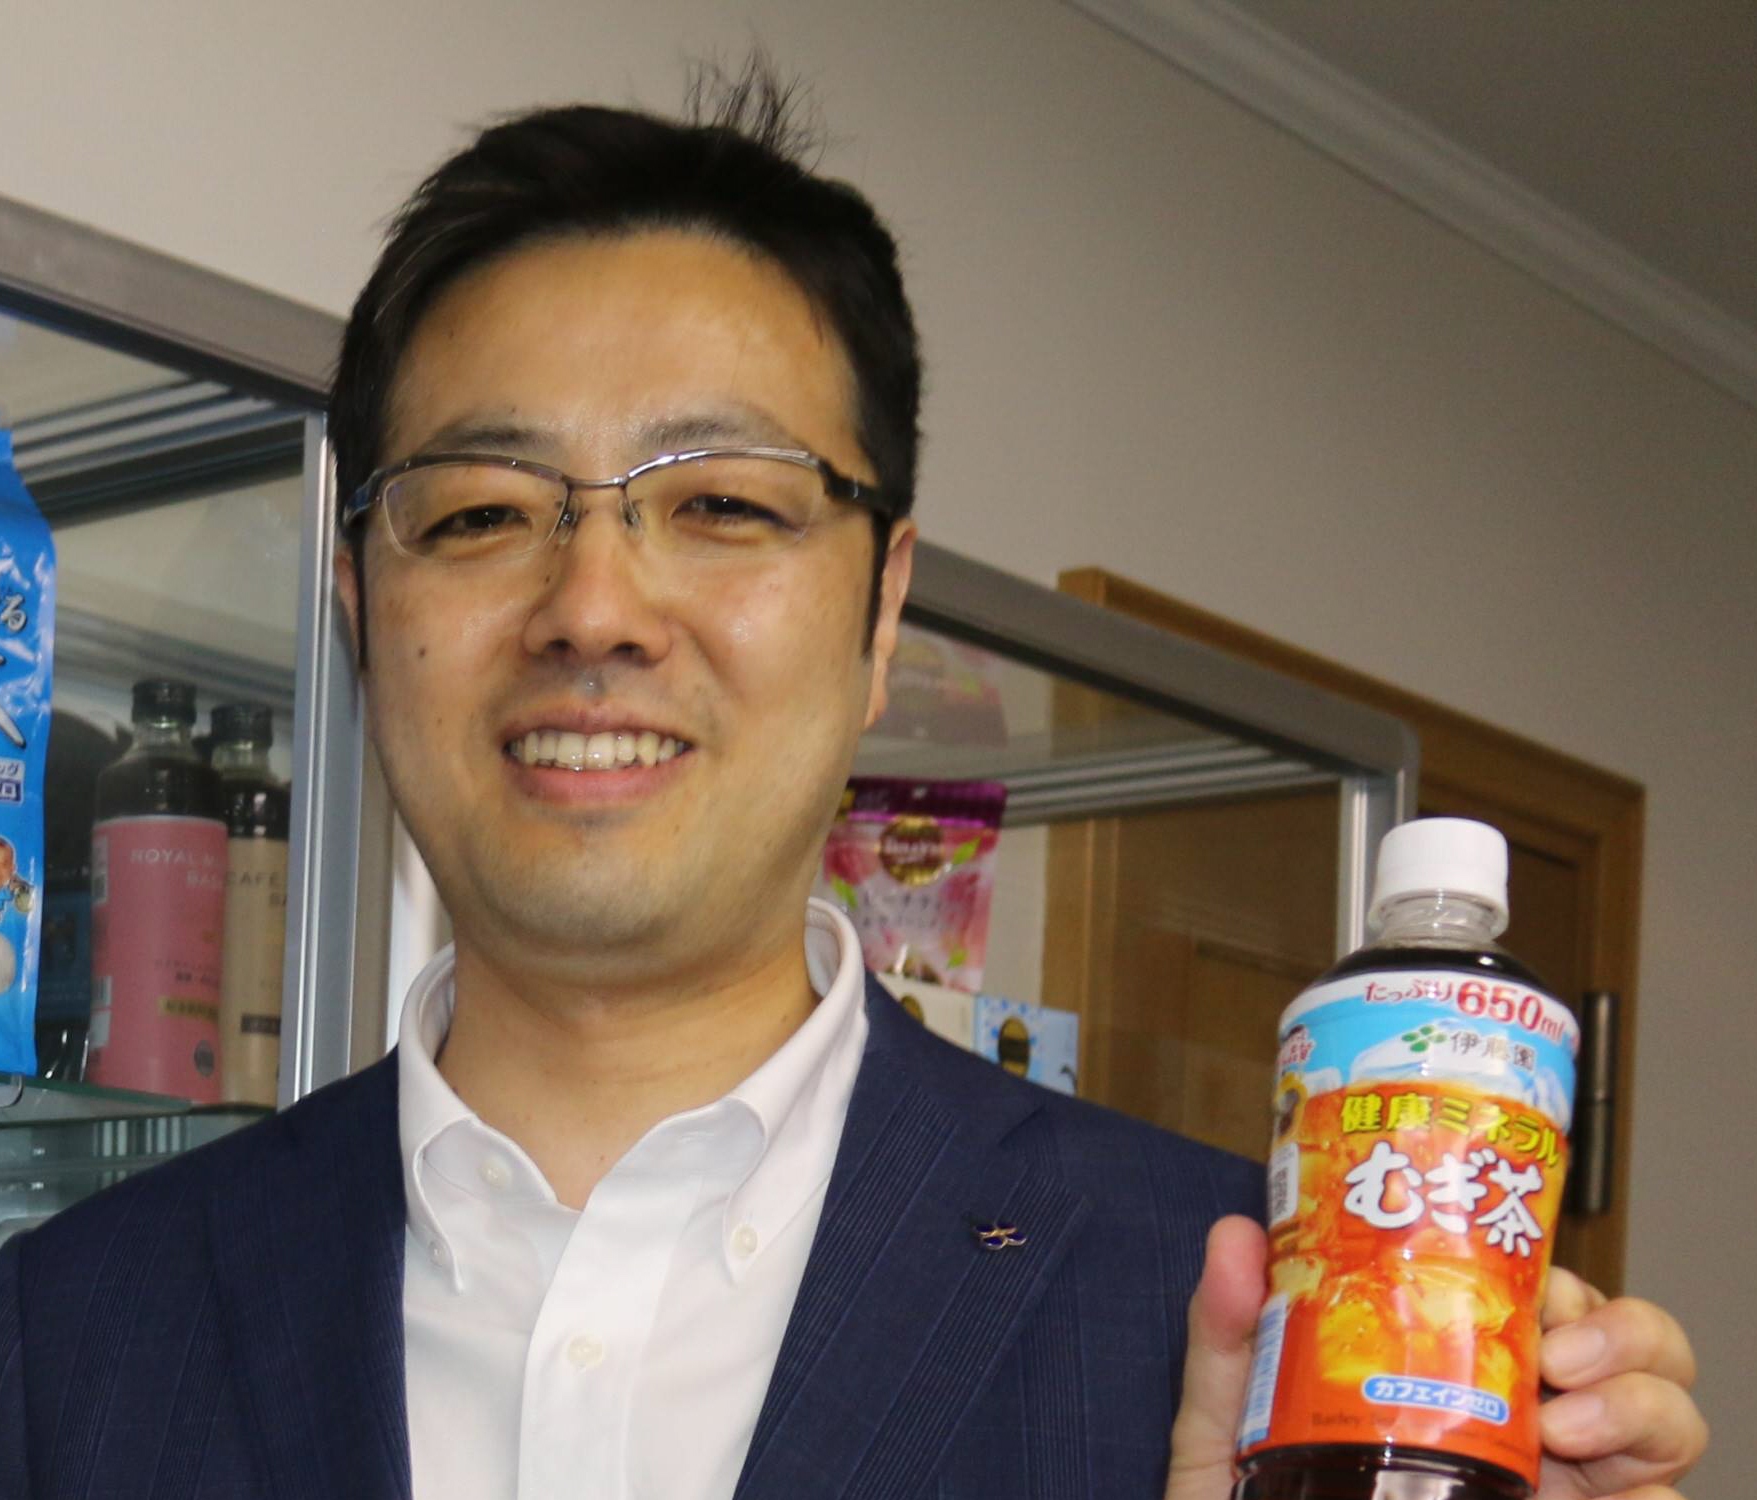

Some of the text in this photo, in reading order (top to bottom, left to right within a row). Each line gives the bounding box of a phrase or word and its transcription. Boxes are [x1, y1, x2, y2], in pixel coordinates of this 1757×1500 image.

[1364, 978, 1565, 1041] たっぷり650ml
[1450, 1030, 1535, 1071] 伊藤園
[1341, 1093, 1559, 1166] 健康ミネラル
[1344, 1140, 1543, 1258] むぎ茶
[1374, 1378, 1501, 1418] カフェインゼロ
